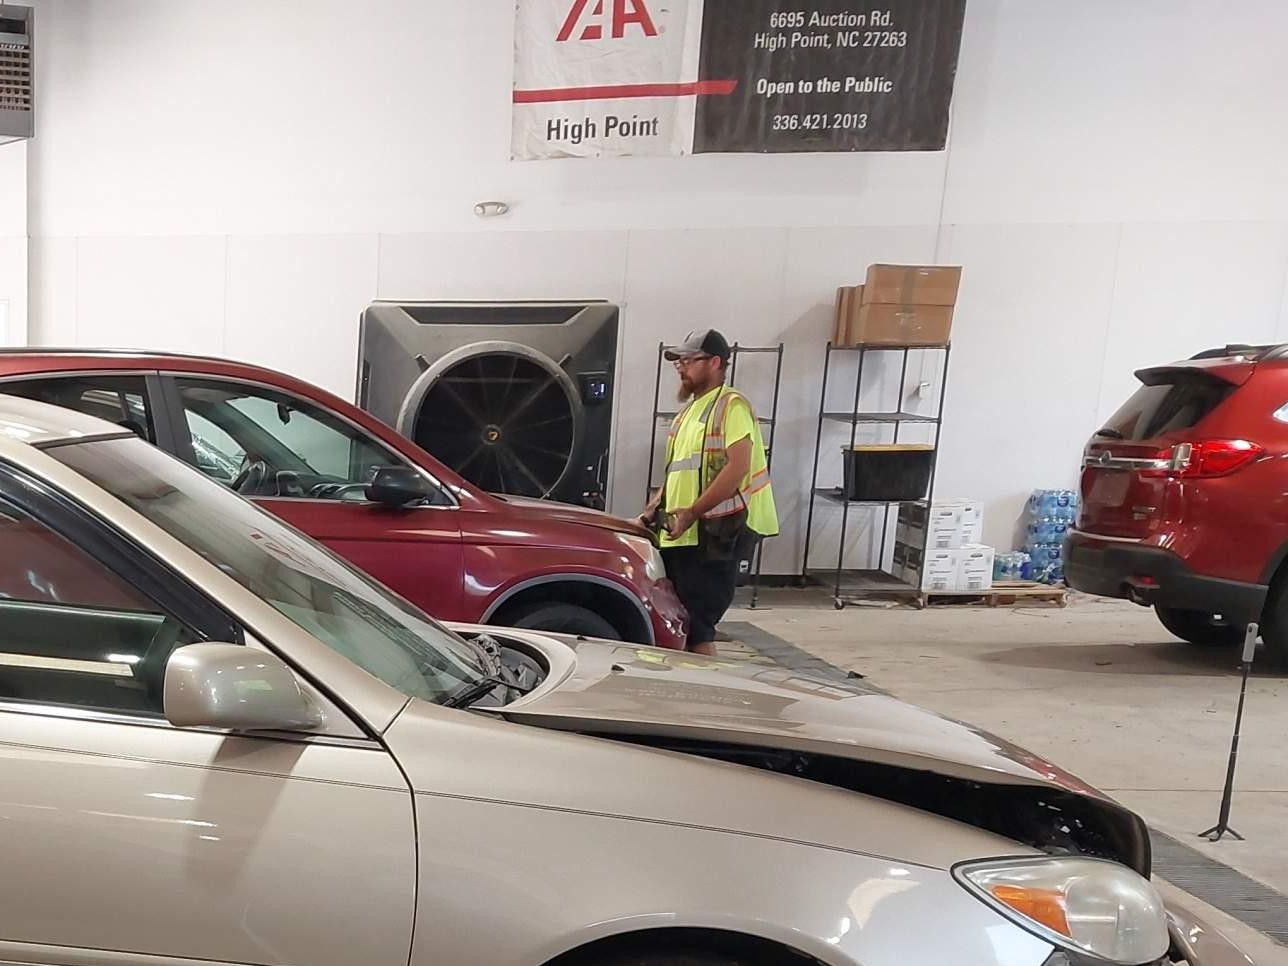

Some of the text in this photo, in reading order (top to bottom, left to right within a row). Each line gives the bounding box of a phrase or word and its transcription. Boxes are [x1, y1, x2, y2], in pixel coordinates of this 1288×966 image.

[770, 10, 894, 28] 6695 Auction Rd.
[754, 31, 907, 52] High Point, NC 27263
[757, 77, 893, 98] Open to the Public
[546, 114, 660, 145] High Point
[772, 113, 868, 130] 336.421.2013
